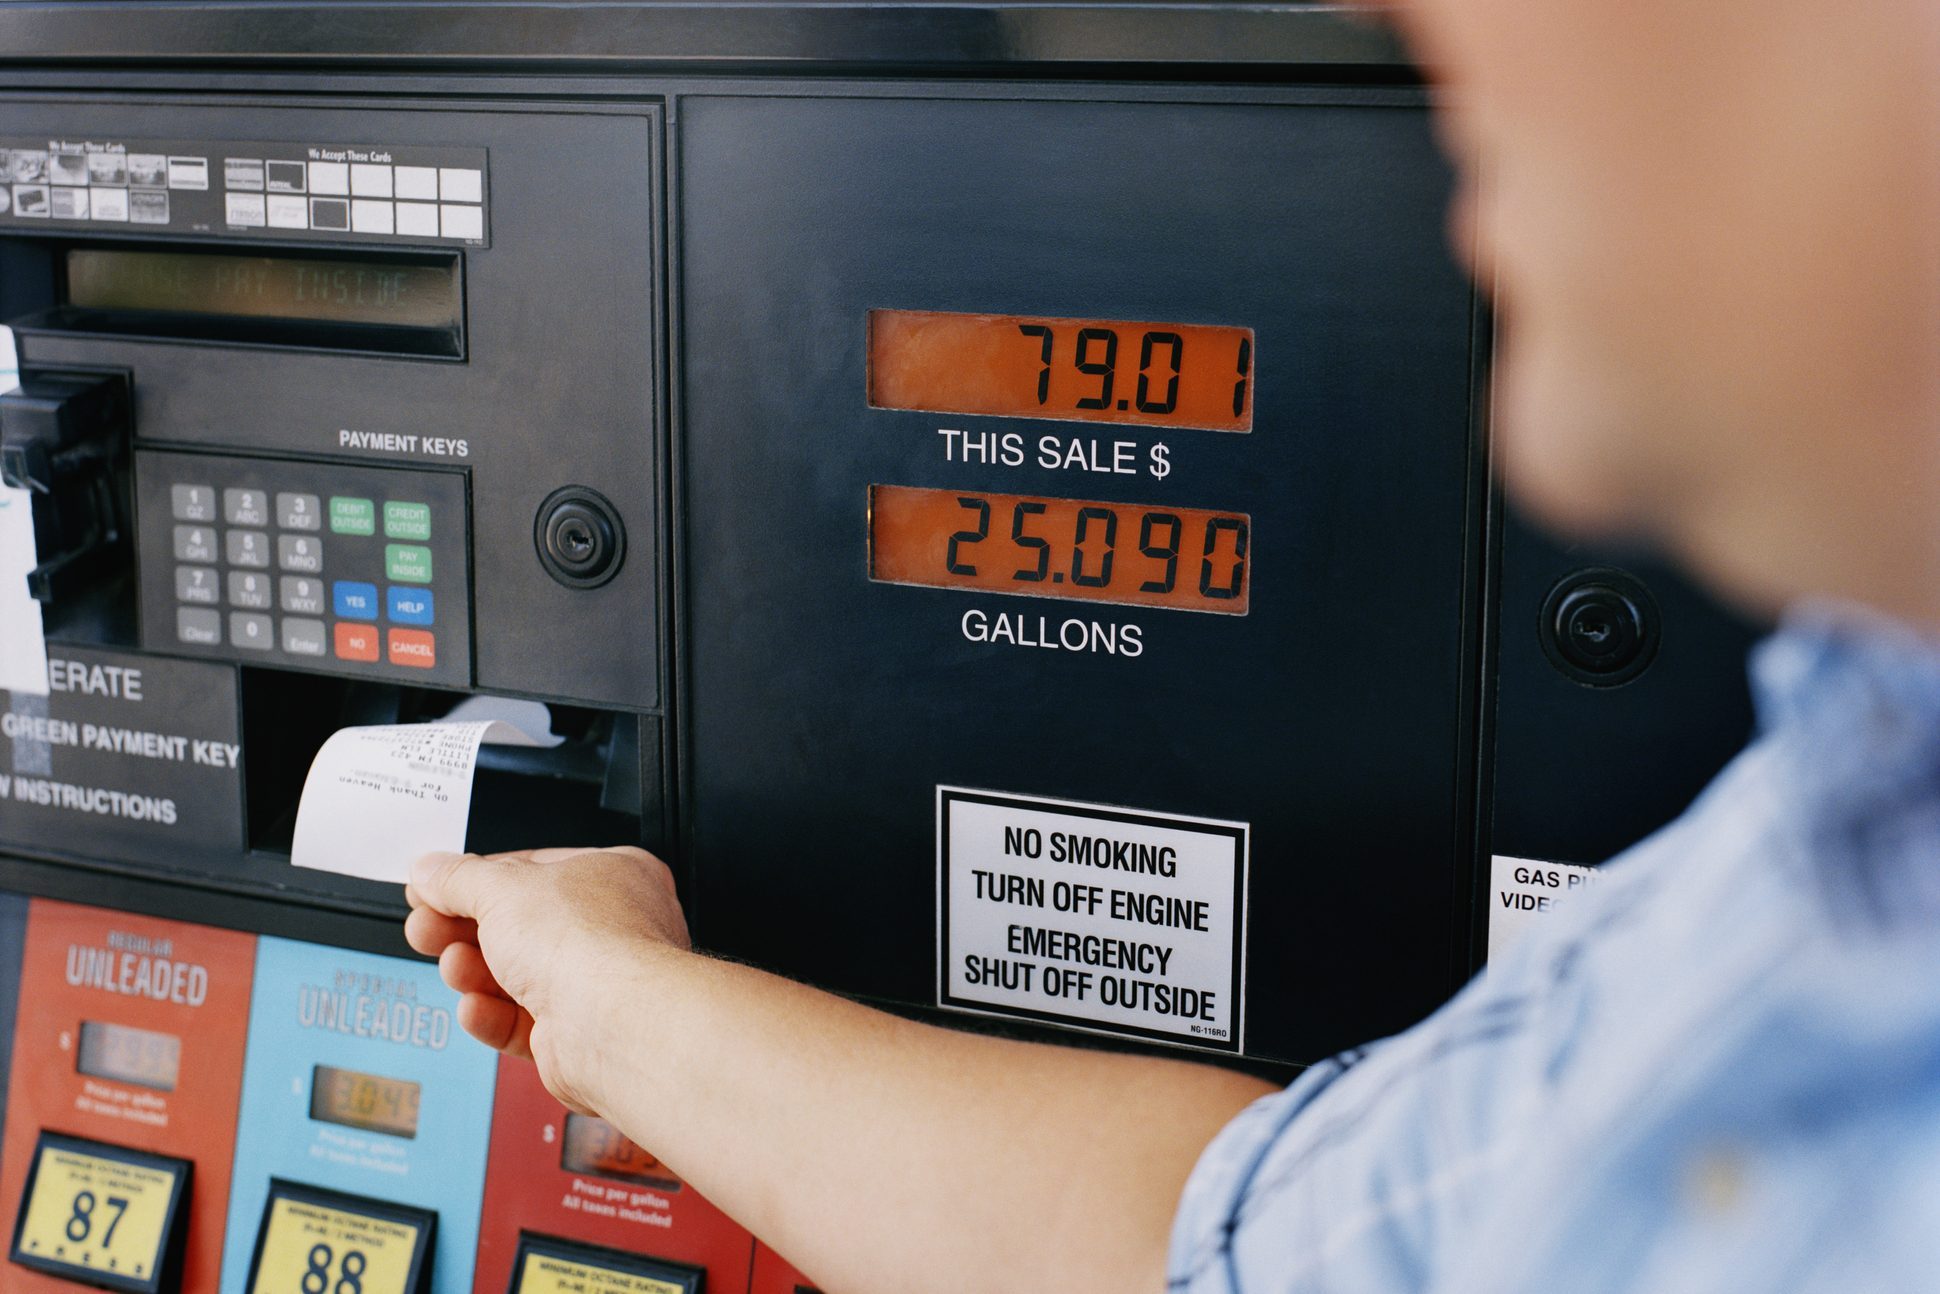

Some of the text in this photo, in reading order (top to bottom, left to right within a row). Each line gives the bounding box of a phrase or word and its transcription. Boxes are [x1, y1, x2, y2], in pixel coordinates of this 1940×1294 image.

[308, 148, 392, 163] We Accept These Cards
[1017, 324, 1251, 418] 79.01
[339, 429, 469, 457] PAYMENT KEYS
[937, 428, 1171, 481] THIS SALE $
[190, 488, 199, 504] 1
[242, 493, 252, 509] 2
[294, 497, 305, 513] 3
[388, 507, 425, 520] CREDIT
[387, 521, 426, 535] OUTSIDE
[190, 530, 202, 545] 4
[243, 534, 254, 550] 5
[296, 539, 307, 555] 6
[946, 496, 1250, 600] 25.090
[398, 550, 418, 562] PAY
[192, 570, 204, 586] 7
[391, 564, 425, 577] INSIDE
[244, 575, 256, 592] 8
[297, 580, 309, 597] 9
[345, 595, 366, 609] YES
[396, 601, 425, 614] HELP
[246, 621, 258, 637] 0
[961, 608, 1144, 657] GALLONS
[289, 637, 319, 653] Enter
[349, 637, 366, 650] NO
[391, 641, 434, 657] CANCEL
[48, 658, 144, 701] ERATE
[1, 711, 240, 769] GREEN PAYMENT KEY
[339, 776, 381, 791] Heaven
[390, 785, 425, 799] Thank
[14, 774, 178, 826] INSTRUCTIONS
[1004, 825, 1177, 878] NO SMOKING
[1514, 867, 1560, 888] GAS
[971, 869, 1209, 932] TURN OFF ENGINE
[1500, 891, 1560, 913] VIDE
[1007, 924, 1173, 976] EMERGENCY
[66, 943, 208, 1007] UNLEADED
[964, 954, 1216, 1022] SHUT OFF OUTSIDE
[298, 982, 450, 1051] UNLEADED
[543, 1124, 555, 1143] $
[572, 1178, 670, 1210] Price per gallon
[65, 1189, 129, 1248] 87
[561, 1194, 673, 1229] All taxes included
[301, 1242, 367, 1294] 88
